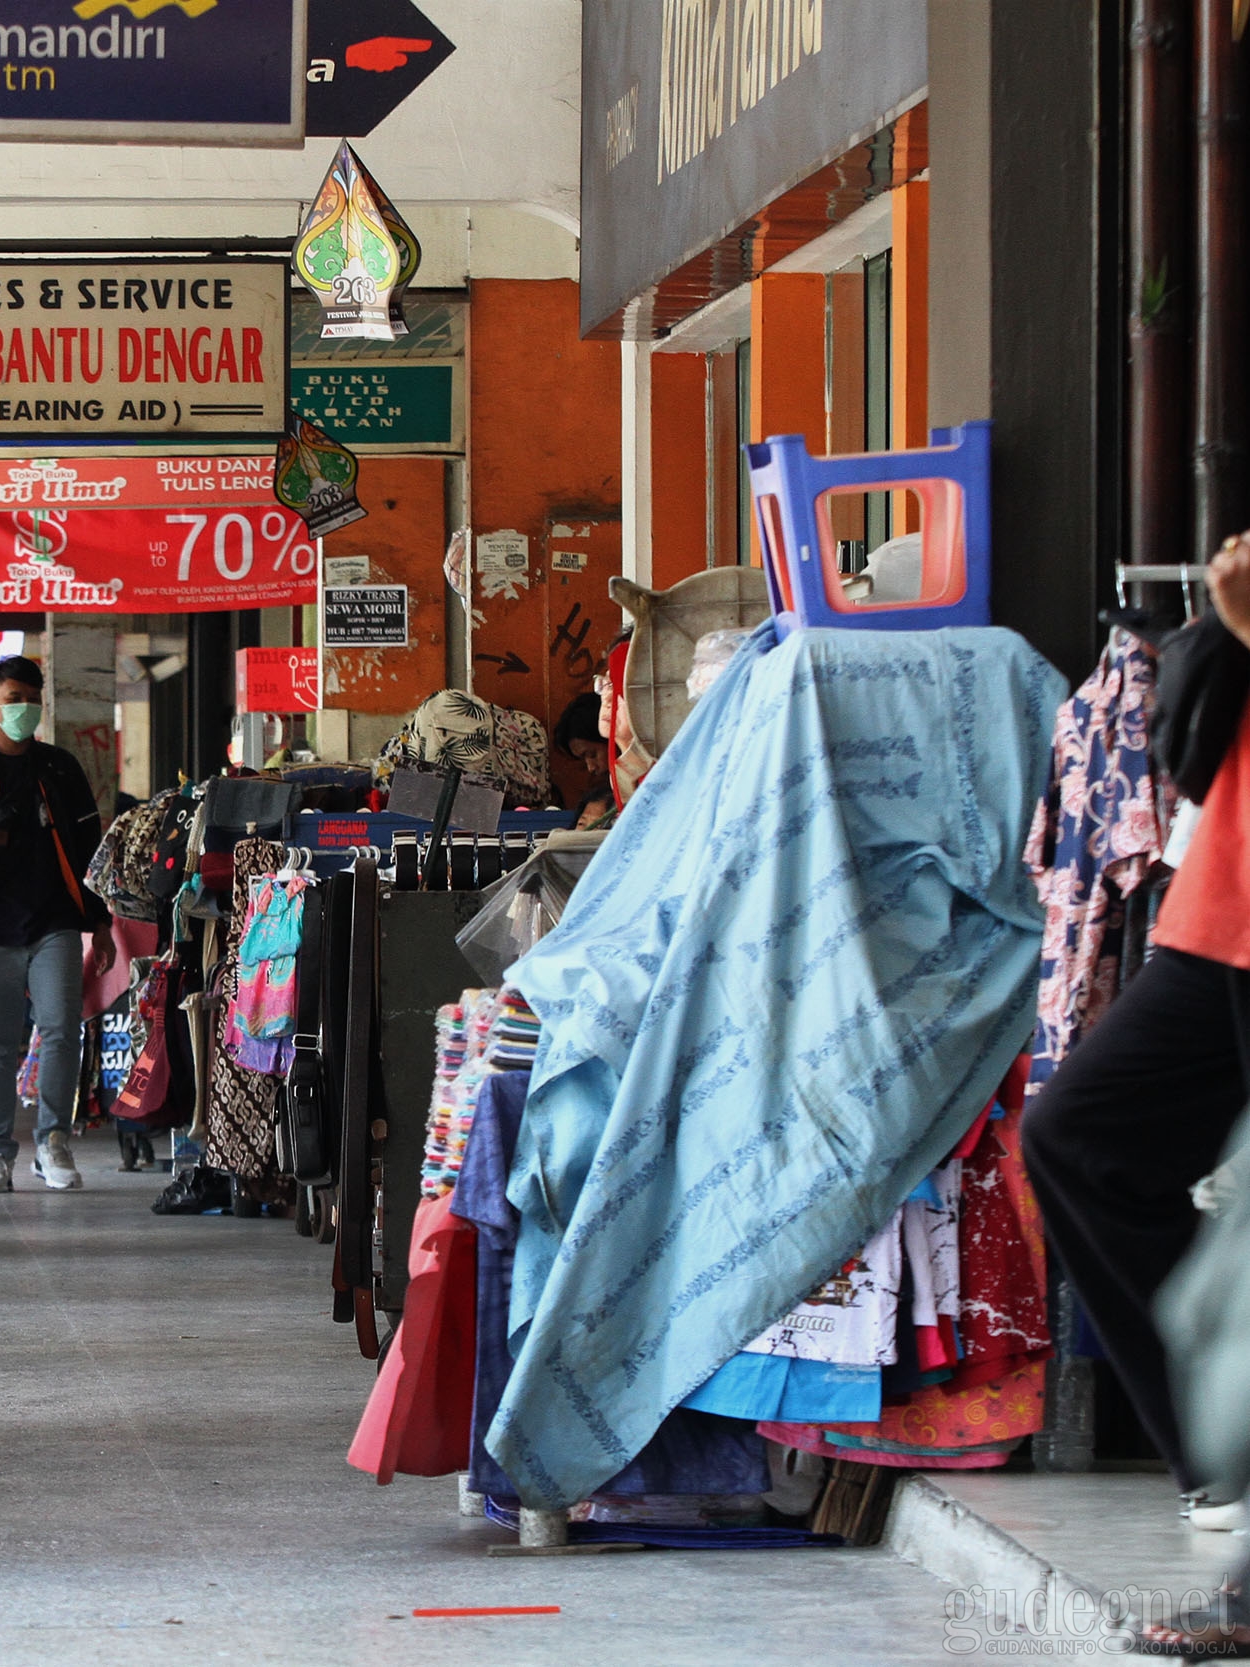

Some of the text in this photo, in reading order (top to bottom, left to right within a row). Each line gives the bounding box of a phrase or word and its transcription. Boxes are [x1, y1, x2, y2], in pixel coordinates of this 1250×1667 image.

[39, 279, 63, 309] &
[77, 279, 233, 313] SERVICE
[333, 277, 377, 304] 263
[118, 327, 264, 384] DENGAR
[308, 375, 385, 385] BUKU
[303, 386, 389, 395] TULIS
[351, 397, 383, 405] CD
[304, 407, 401, 417] KOLAH
[312, 418, 393, 427] AKAN
[156, 460, 211, 474] BUKU
[217, 459, 261, 473] DAN
[13, 471, 74, 480] Toko Buku
[161, 475, 273, 491] TULIS LENG
[43, 481, 118, 500] Ilmu
[307, 482, 344, 512] 263
[149, 541, 168, 554] up
[166, 512, 315, 581] 70%
[151, 556, 166, 567] to
[12, 567, 72, 576] Toko Buku
[41, 579, 117, 603] Ilmu
[332, 591, 400, 600] RIZKY TRANS
[326, 604, 405, 615] SEWA MOBIL
[253, 682, 278, 697] pia
[778, 1313, 835, 1333] ngan
